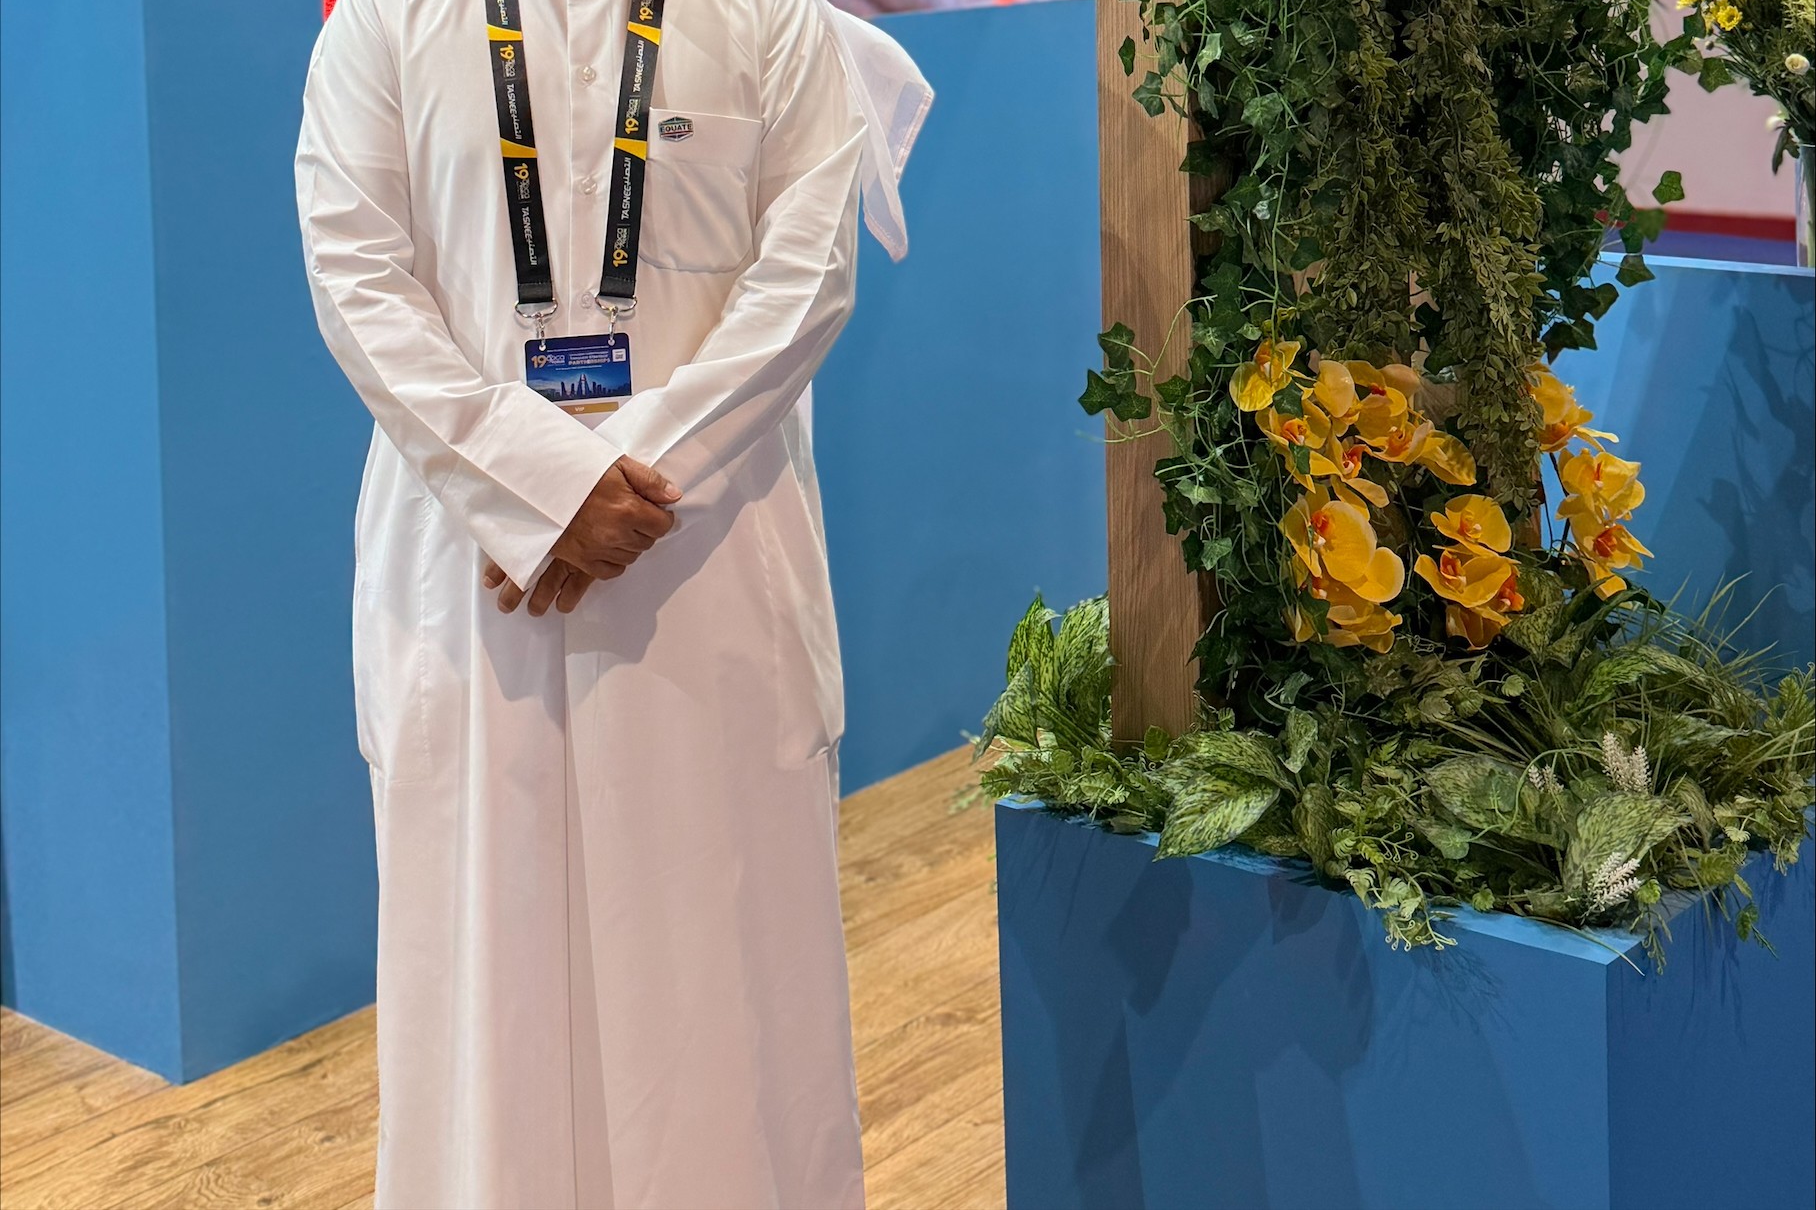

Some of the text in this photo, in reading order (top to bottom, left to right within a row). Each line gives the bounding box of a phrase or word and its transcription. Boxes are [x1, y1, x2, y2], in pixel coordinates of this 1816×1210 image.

[639, 7, 654, 21] 19
[500, 44, 515, 60] 19
[632, 62, 644, 92] TASNEE
[506, 83, 517, 115] TASNEE
[625, 118, 640, 134] 19
[514, 163, 529, 180] 19
[521, 206, 533, 239] TASNEE
[612, 249, 628, 268] 19
[621, 185, 632, 220] TASNEE
[531, 355, 547, 368] 19
